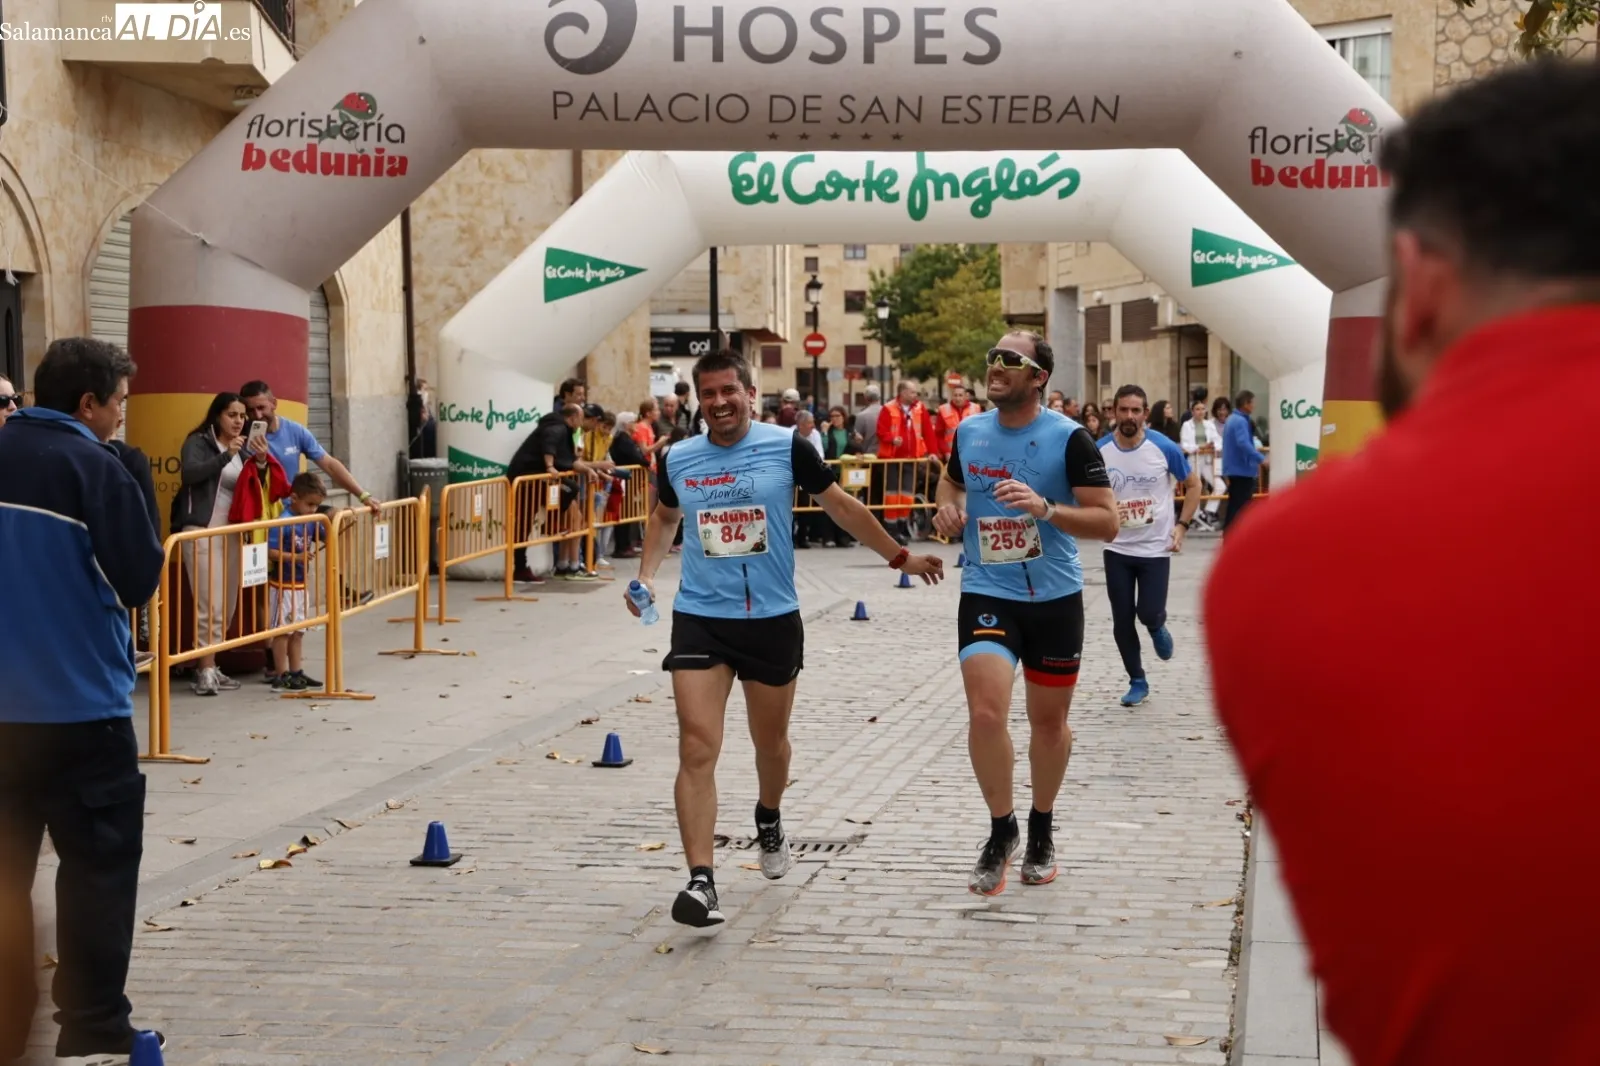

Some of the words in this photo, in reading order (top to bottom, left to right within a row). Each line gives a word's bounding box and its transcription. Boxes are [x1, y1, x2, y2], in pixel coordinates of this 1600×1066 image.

[671, 5, 1002, 66] HOSPES
[552, 89, 750, 124] PALACIO
[767, 93, 823, 125] DE
[838, 94, 924, 125] SAN
[940, 94, 1121, 125] ESTEBAN
[246, 112, 406, 144] floristería
[1248, 126, 1386, 155] floristerí
[241, 142, 408, 178] bedunia
[1250, 158, 1392, 190] beduni
[727, 151, 779, 206] El
[782, 153, 901, 206] Corte
[907, 151, 1081, 222] Inglés
[545, 265, 557, 279] El
[557, 265, 585, 279] Corte
[585, 261, 625, 283] Inglés
[1192, 250, 1206, 264] El
[1206, 250, 1236, 265] Corte
[1235, 248, 1278, 270] Inglés
[447, 403, 484, 424] Corte
[485, 399, 542, 431] Inglés
[1280, 399, 1294, 420] El
[1294, 399, 1322, 420] Cor
[709, 488, 750, 500] FLOWERS
[720, 524, 747, 544] 84
[989, 530, 1027, 551] 256
